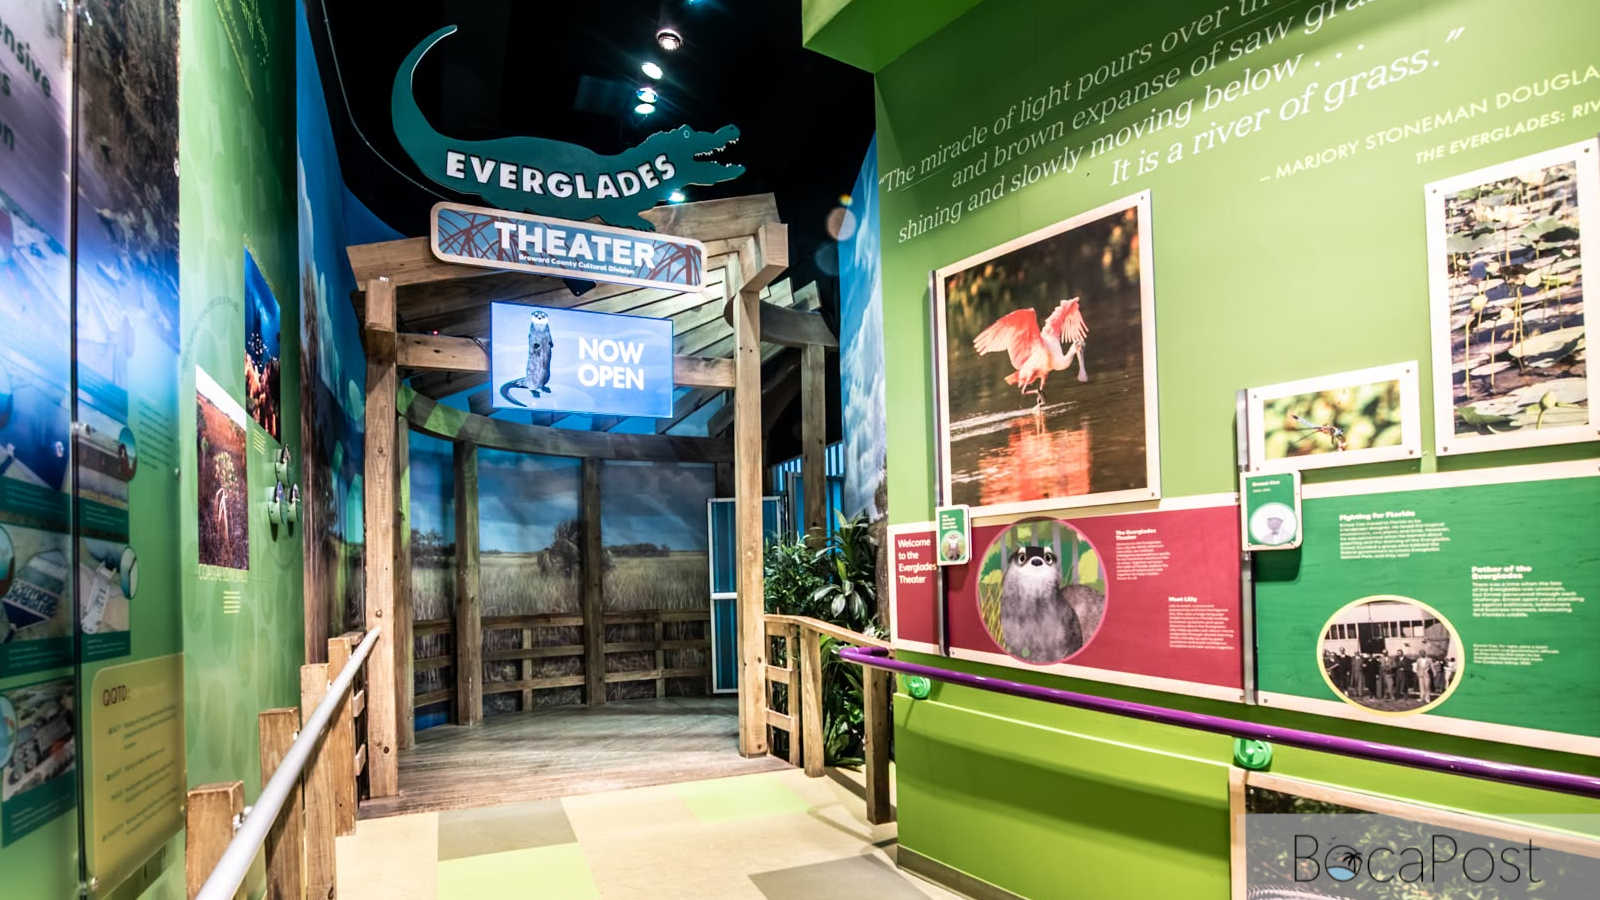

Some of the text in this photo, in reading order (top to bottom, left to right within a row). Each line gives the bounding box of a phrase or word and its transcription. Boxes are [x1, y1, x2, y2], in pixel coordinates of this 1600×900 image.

[0, 16, 51, 98] nsive
[920, 126, 988, 175] miracle
[993, 104, 1017, 135] of
[1019, 80, 1072, 123] light
[1078, 43, 1152, 100] pours
[1161, 5, 1230, 53] over
[951, 151, 988, 188] and
[993, 120, 1064, 168] brown
[1072, 67, 1181, 130] expanse
[1190, 40, 1224, 77] of
[1228, 15, 1295, 62] saw
[898, 200, 963, 244] shining
[967, 175, 1005, 212] and
[1009, 145, 1084, 192] slowly
[1089, 98, 1194, 159] moving
[1202, 53, 1304, 113] below
[1110, 158, 1131, 187] It
[1137, 149, 1159, 176] is
[1167, 141, 1184, 164] a
[1192, 107, 1271, 155] river
[1279, 82, 1319, 121] of
[1275, 139, 1360, 179] MARJORY
[1365, 98, 1488, 150] STONEMAN
[1415, 143, 1446, 164] THE
[1449, 110, 1566, 155] EVERGLADES:
[445, 153, 676, 200] EVERGLADES
[494, 220, 656, 269] THEATER
[518, 253, 635, 275] Broward County Cultural Division
[578, 337, 645, 364] NOW
[577, 364, 645, 391] OPEN
[897, 538, 931, 549] Welcome
[898, 551, 919, 560] to the
[898, 562, 937, 573] Everglades
[899, 575, 926, 584] Theater
